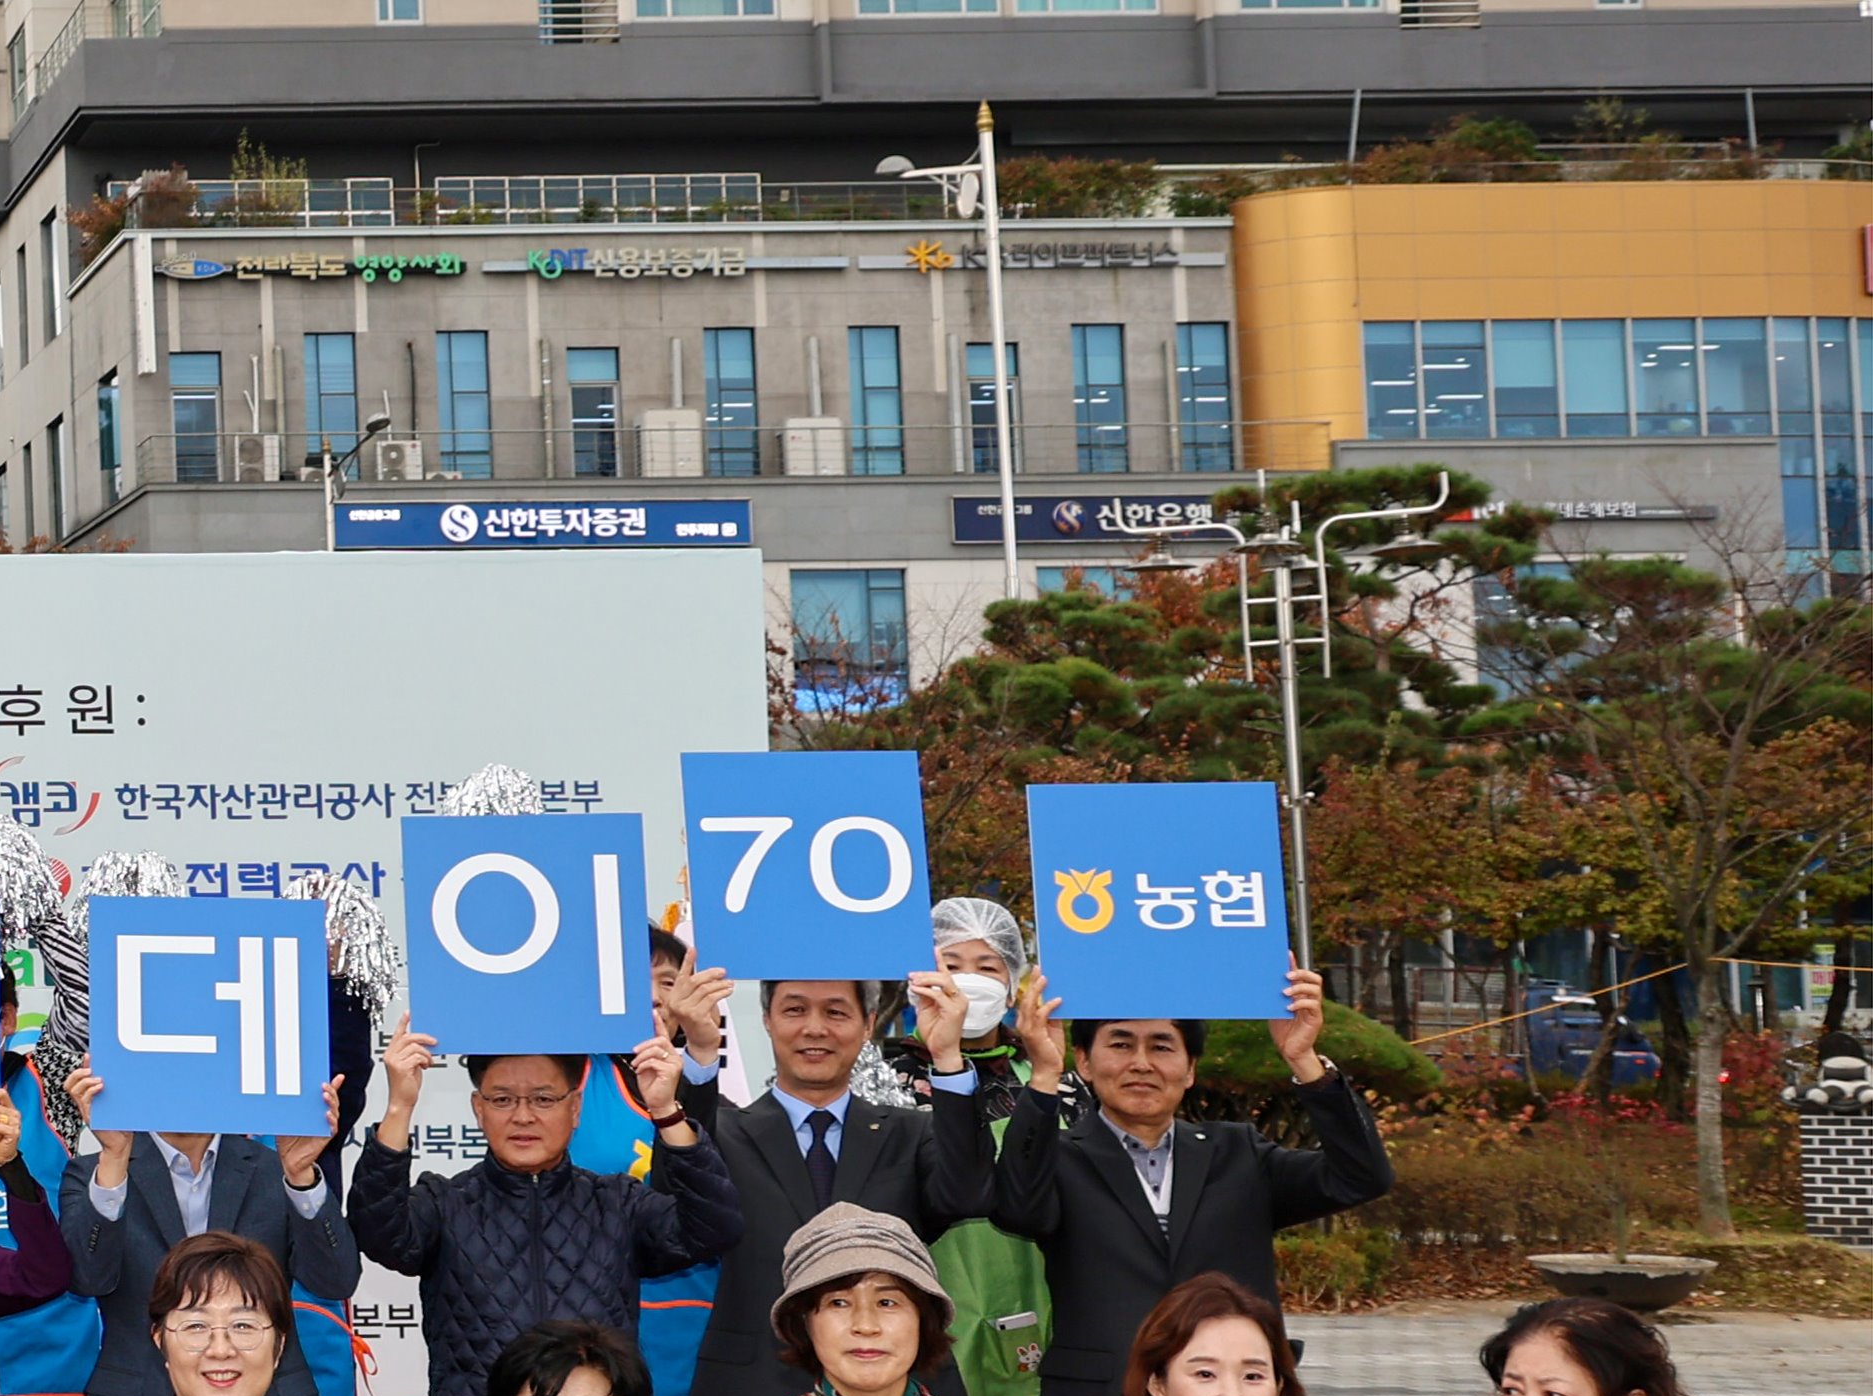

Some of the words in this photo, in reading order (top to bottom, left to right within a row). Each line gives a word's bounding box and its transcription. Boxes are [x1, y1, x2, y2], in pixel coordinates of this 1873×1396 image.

[237, 253, 348, 281] 전라북도
[355, 252, 460, 283] 영양사회
[527, 248, 588, 279] KODIT
[591, 247, 746, 278] 신용보증기금
[961, 241, 1180, 269] K라이프파트너스
[483, 508, 647, 537] 신한투자증권
[1096, 501, 1213, 531] 신한은행
[1546, 501, 1636, 518] 데손해보험
[0, 781, 78, 828] 캠코
[115, 783, 394, 820] 한국자산관리공사
[1135, 871, 1265, 929] 농협
[117, 936, 300, 1095] 데
[432, 854, 625, 1014] 이
[701, 817, 911, 912] 70
